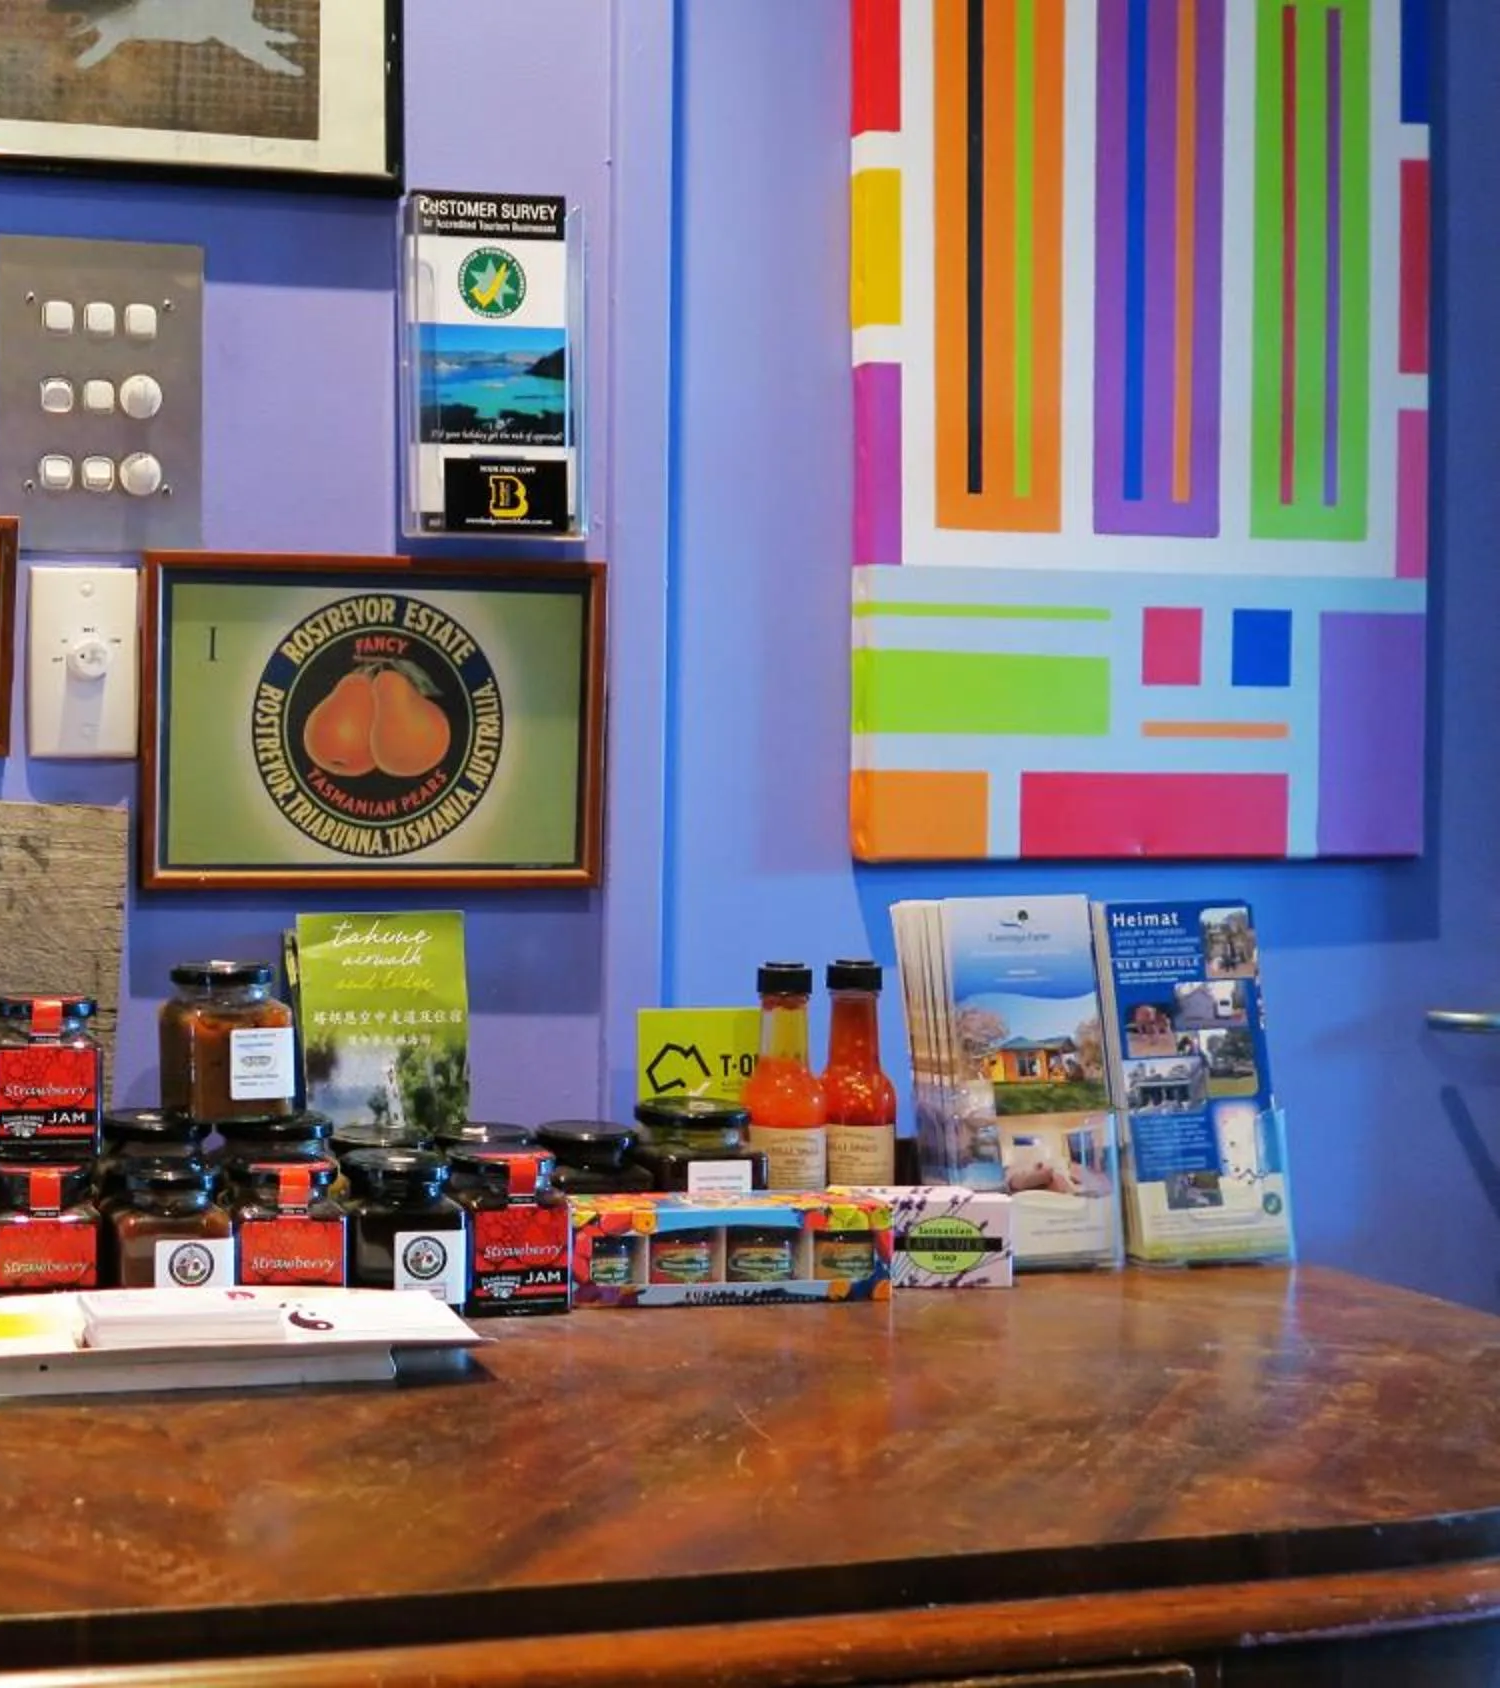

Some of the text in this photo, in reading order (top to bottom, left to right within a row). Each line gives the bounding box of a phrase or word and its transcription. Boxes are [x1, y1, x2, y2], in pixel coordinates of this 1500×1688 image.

[419, 199, 557, 221] CUSTOMER SURVEY
[280, 597, 476, 666] ROSTREVOR ESTATE
[354, 635, 411, 655] FANCY
[306, 769, 449, 818] TASMANIAN PEARS
[1113, 911, 1179, 928] Heimat
[47, 1111, 88, 1125] JAM
[525, 1270, 562, 1285] JAM
